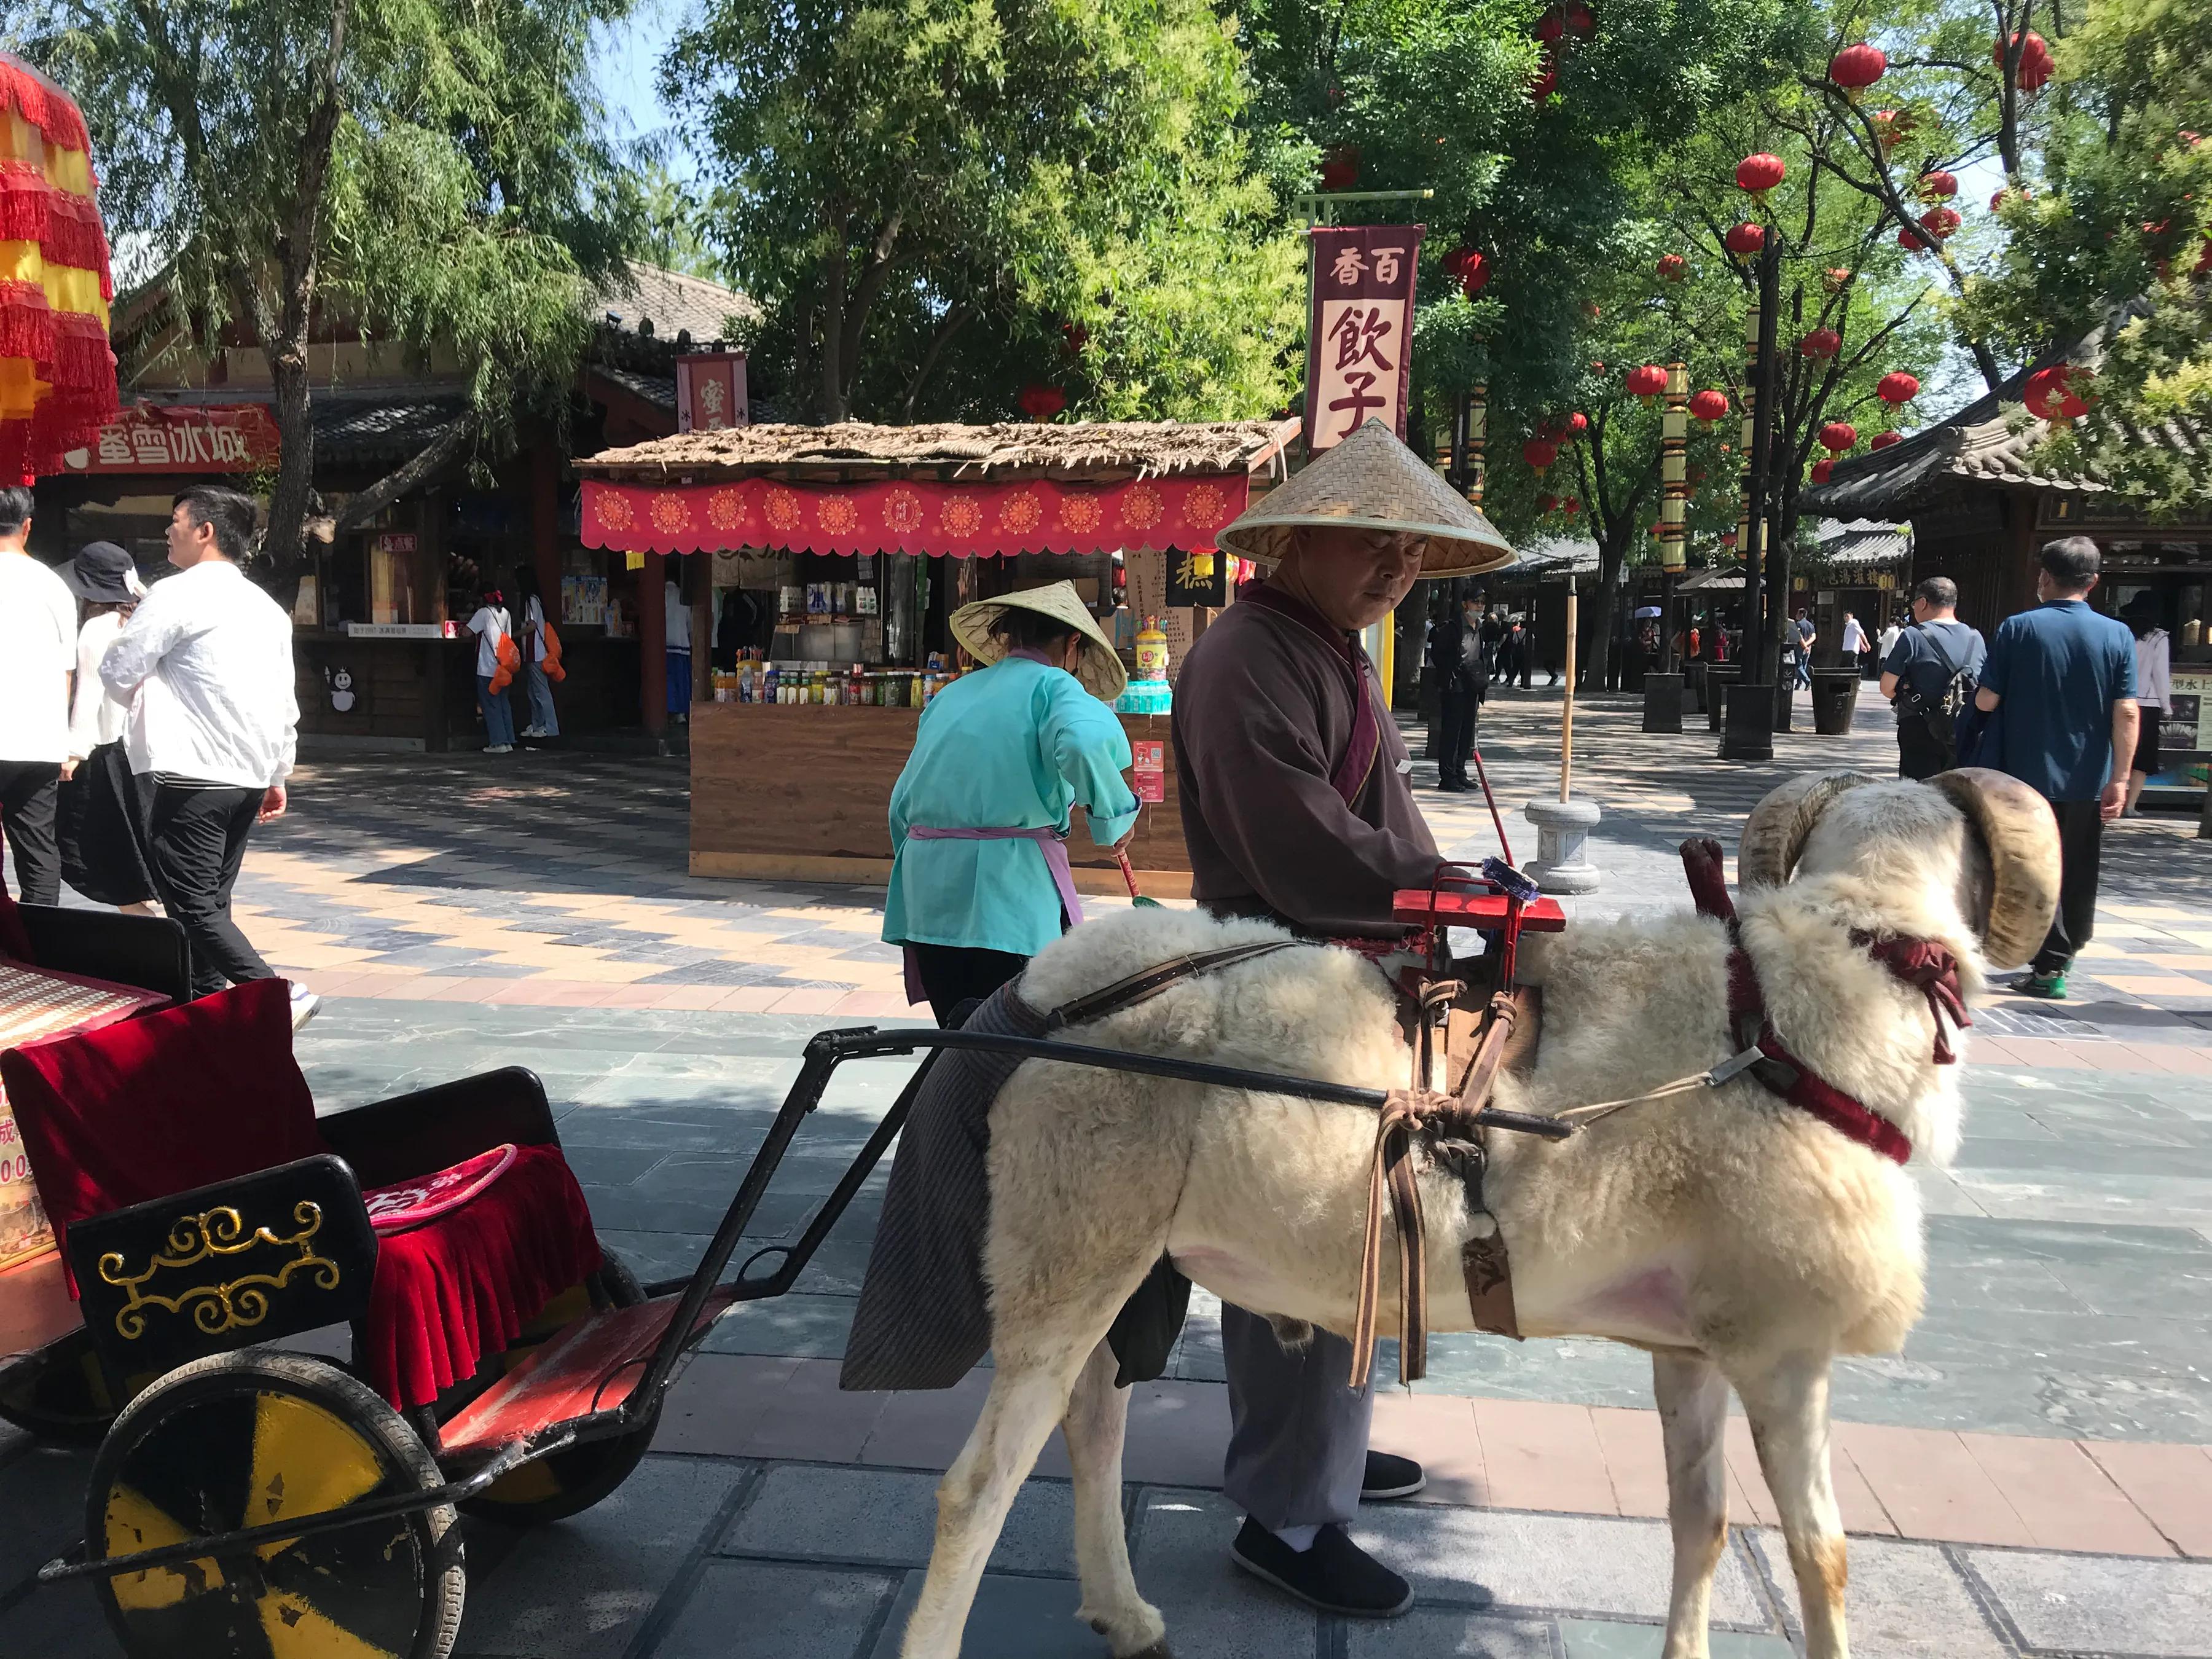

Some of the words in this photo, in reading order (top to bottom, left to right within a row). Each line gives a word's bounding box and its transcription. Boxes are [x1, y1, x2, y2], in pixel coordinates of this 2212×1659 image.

[1328, 306, 1394, 439] 飲子
[98, 418, 249, 465] 蜜雪冰城
